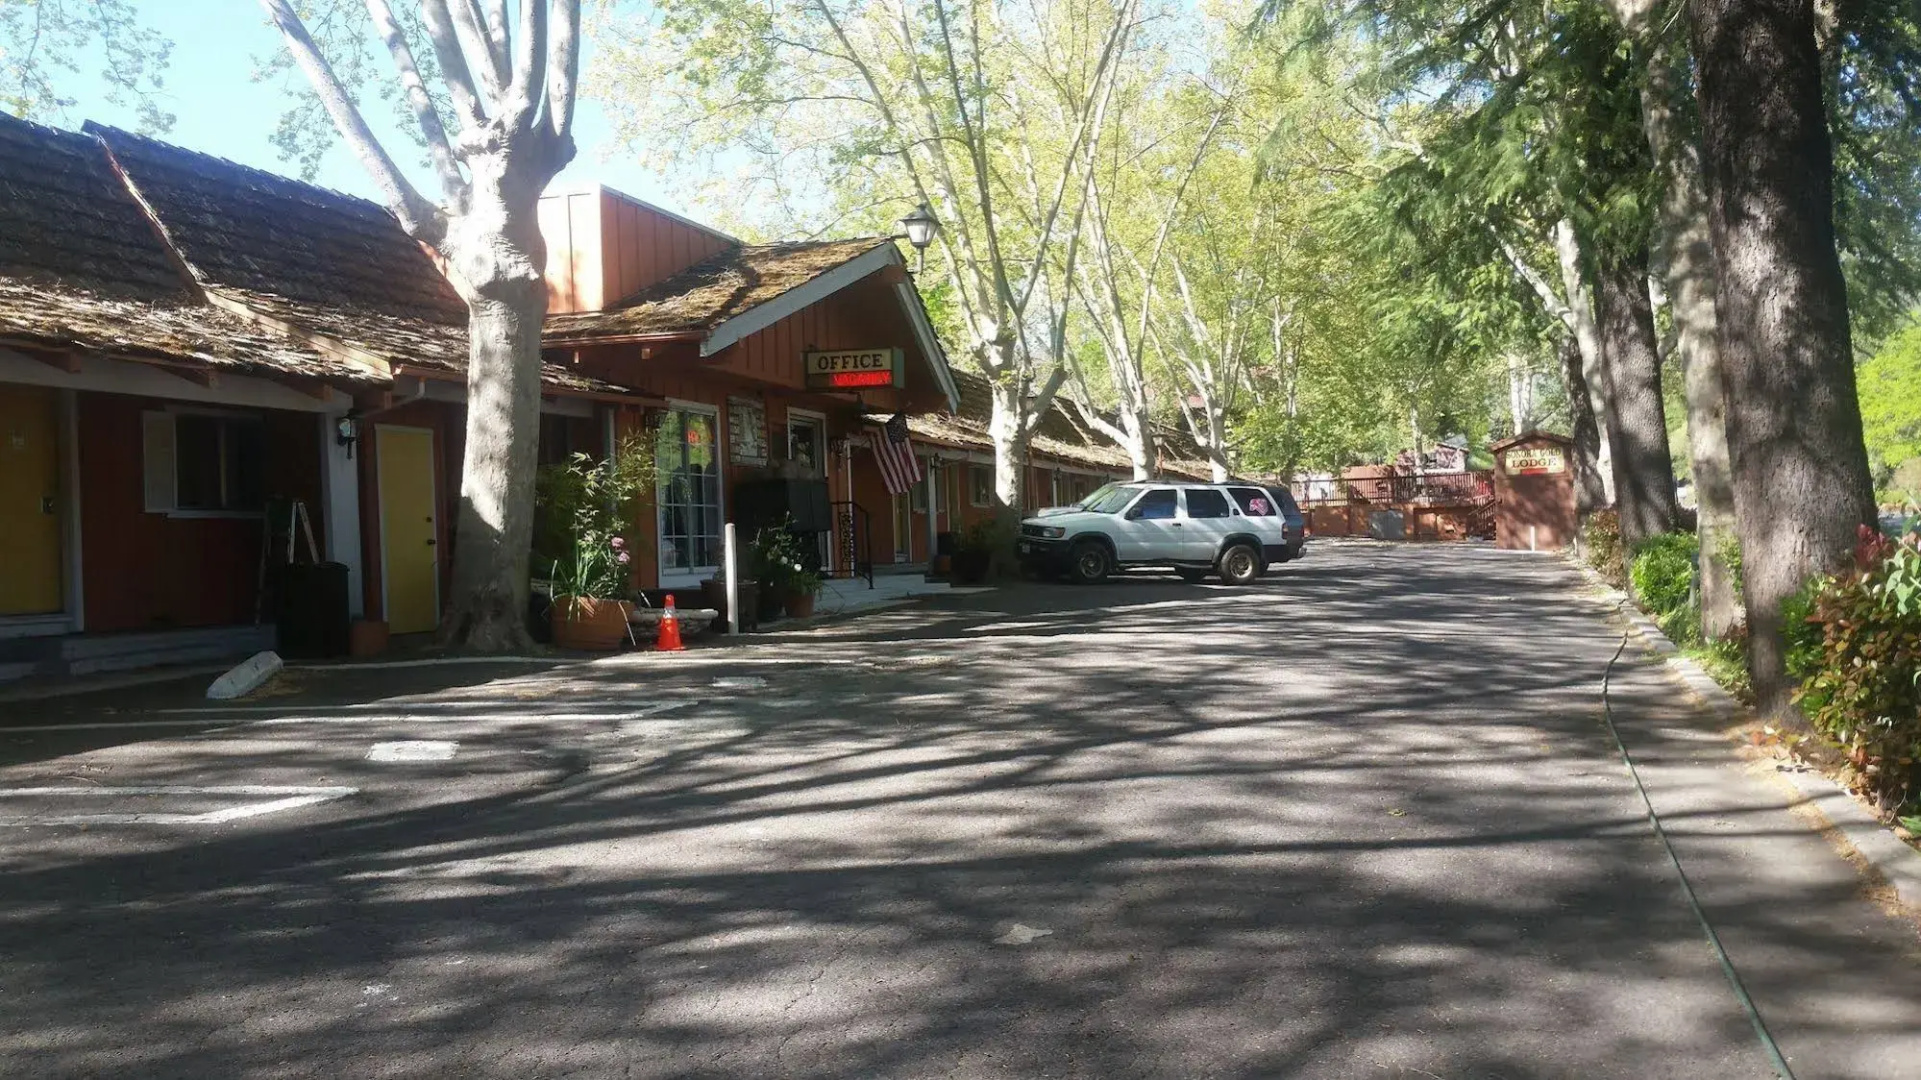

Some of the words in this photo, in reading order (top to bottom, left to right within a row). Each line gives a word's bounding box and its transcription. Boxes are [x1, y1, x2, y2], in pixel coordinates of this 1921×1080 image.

[818, 353, 883, 370] OFFICE
[1540, 448, 1561, 457] GOLD
[1512, 458, 1557, 468] LODGE
